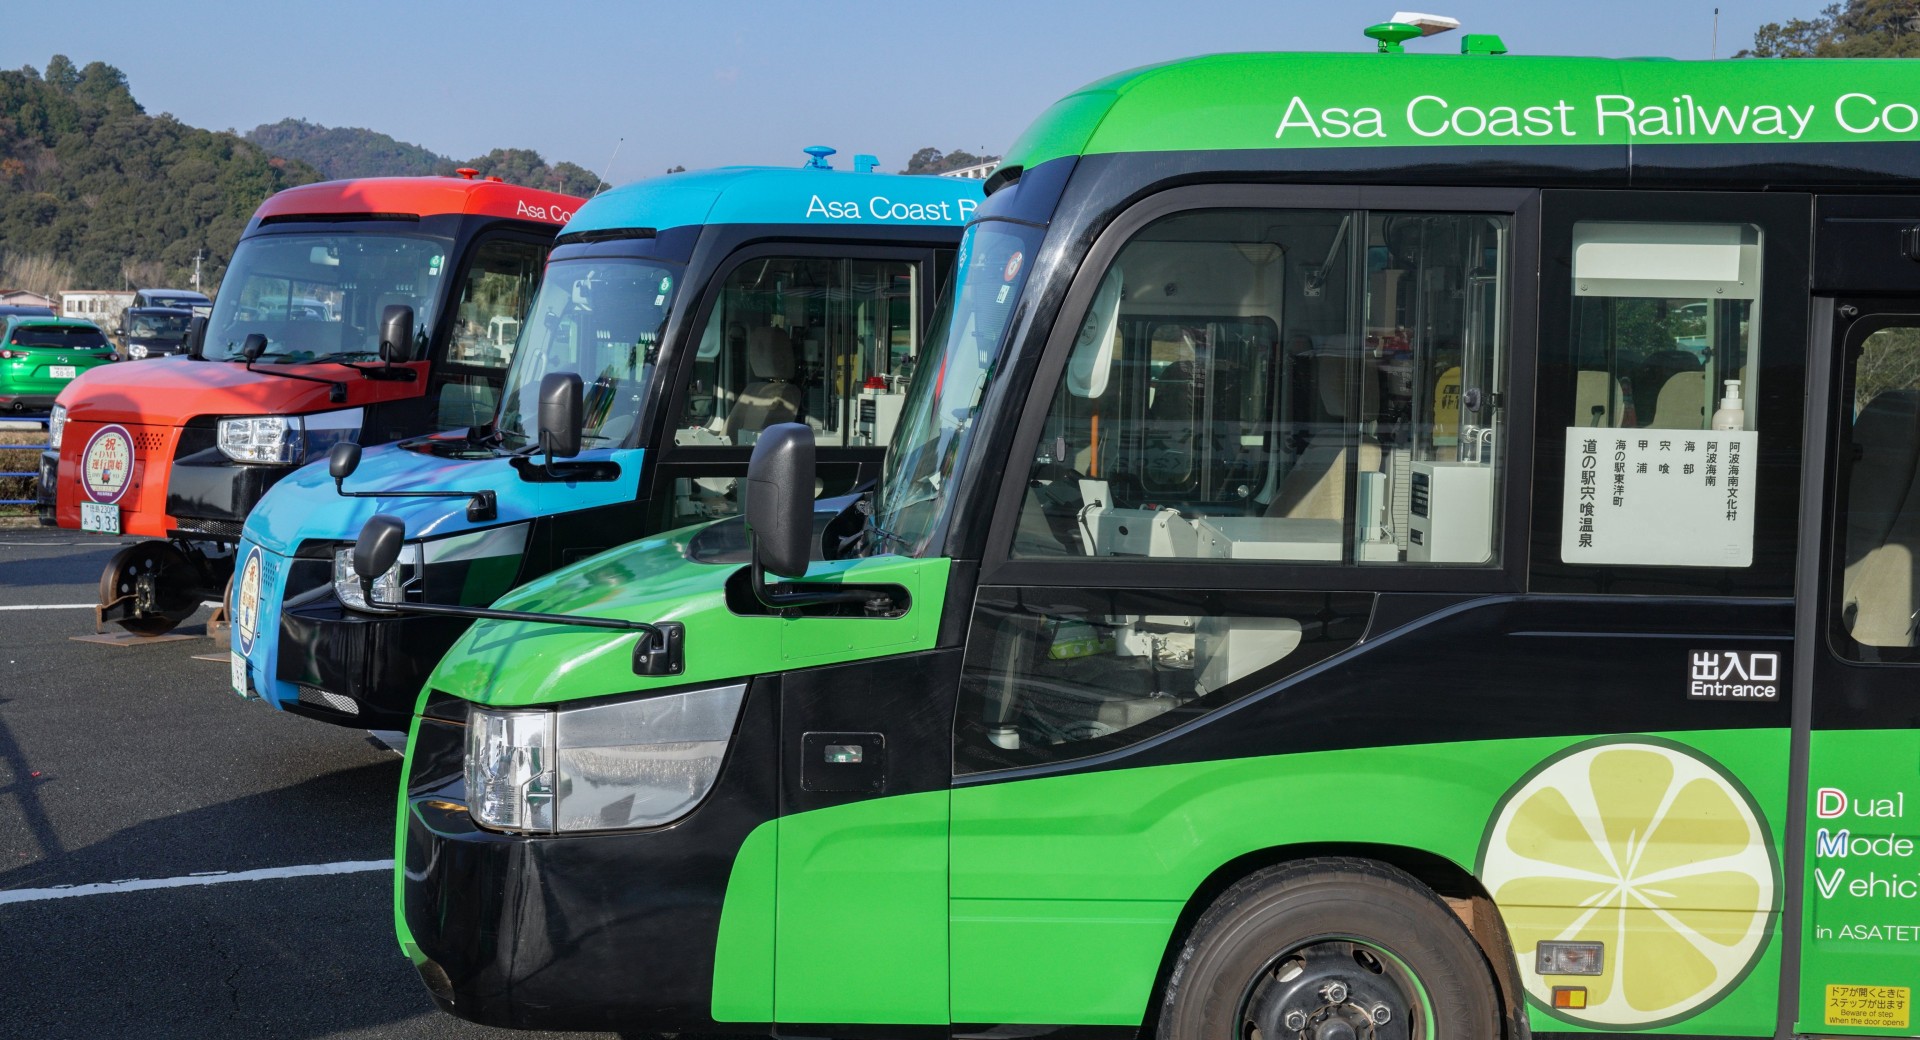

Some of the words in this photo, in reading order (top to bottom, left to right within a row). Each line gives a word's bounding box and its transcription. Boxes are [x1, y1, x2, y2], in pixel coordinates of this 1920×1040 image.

[1275, 96, 1387, 139] Asa
[1406, 94, 1577, 138] Coast
[1595, 94, 1815, 140] Railway
[516, 199, 547, 220] Asa
[550, 205, 575, 223] Co
[805, 194, 862, 219] Asa
[869, 196, 952, 221] Coast
[105, 437, 117, 451] 祝
[1636, 439, 1649, 474] 甲浦
[1658, 440, 1671, 475] 宍喰
[1682, 440, 1696, 475] 海部
[92, 459, 123, 471] 運行開始
[1612, 439, 1627, 507] 海の駅東洋町
[1705, 441, 1718, 487] 阿波海南
[1578, 438, 1598, 548] 道の駅宍喰温泉
[1726, 441, 1741, 521] 阿波海南文化村
[1692, 651, 1778, 681] 出入口
[1691, 681, 1776, 697] Entrance
[1816, 828, 1914, 858] Mode
[1814, 868, 1920, 899] Vehic
[1816, 924, 1833, 939] in
[1830, 998, 1905, 1010] ステップが出ます
[1832, 986, 1905, 999] ドアが開くときに
[1829, 1016, 1849, 1024] When
[1850, 1017, 1863, 1025] the
[1863, 1018, 1881, 1026] door
[1882, 1019, 1905, 1027] opens
[1840, 1009, 1868, 1017] Beware
[1877, 1011, 1894, 1019] step
